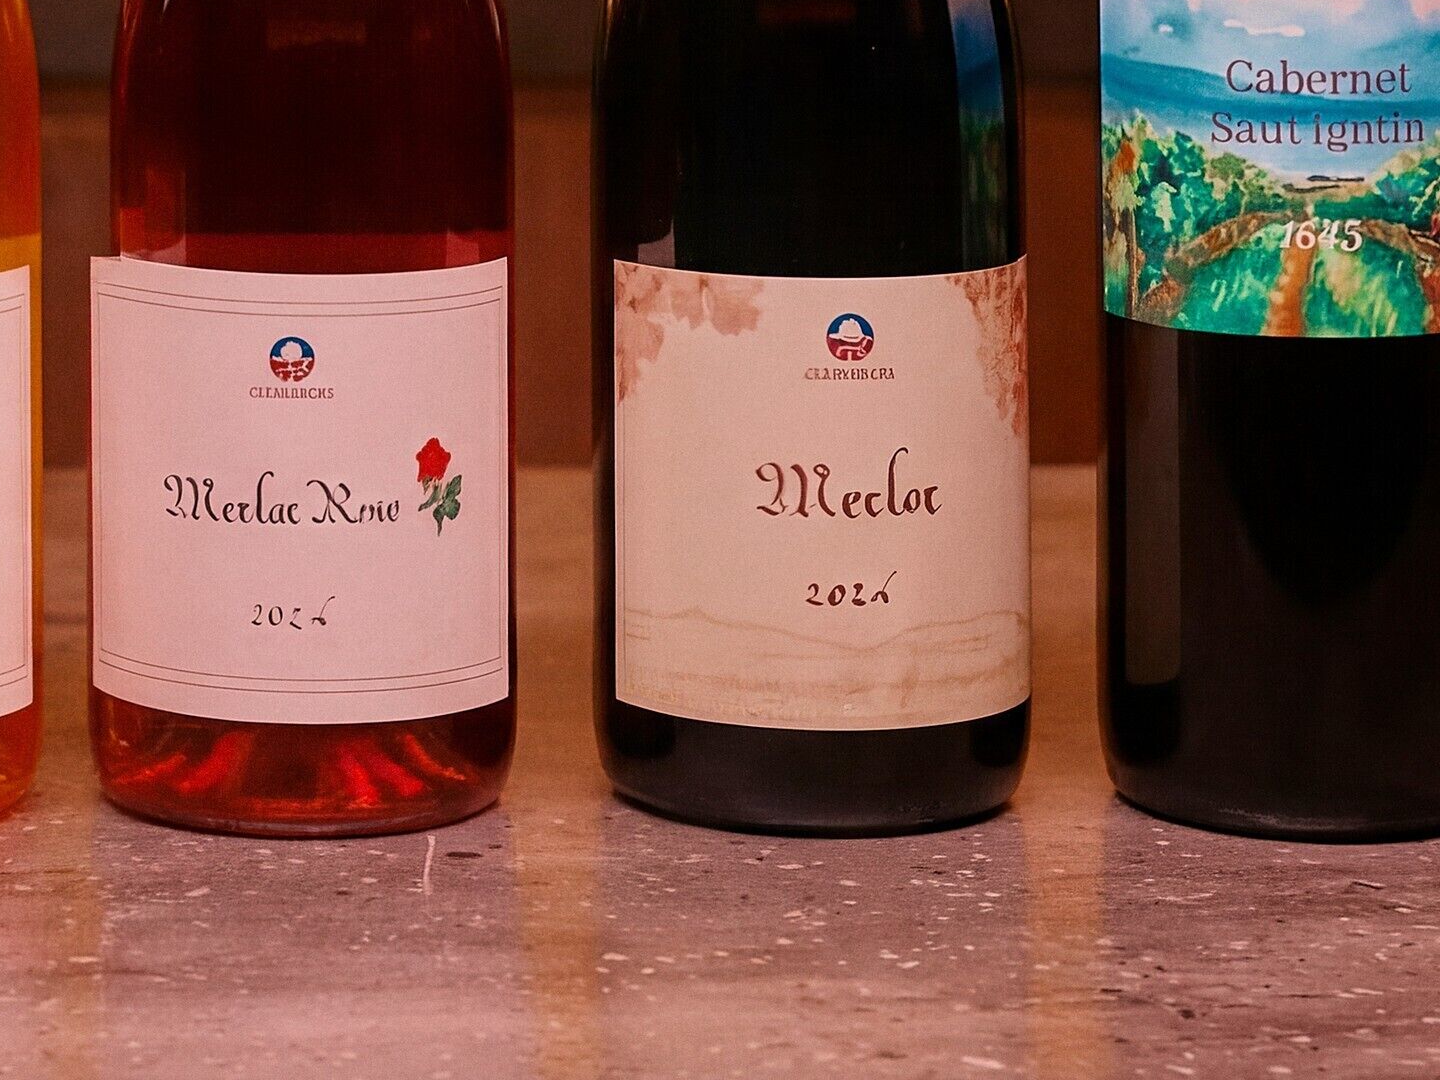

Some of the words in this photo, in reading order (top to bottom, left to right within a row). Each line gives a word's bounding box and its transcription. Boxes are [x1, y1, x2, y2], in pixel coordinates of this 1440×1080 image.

[1225, 59, 1412, 95] Cabernet
[1211, 111, 1302, 145] Saut
[1313, 111, 1425, 153] igntin
[1279, 217, 1363, 253] 1645
